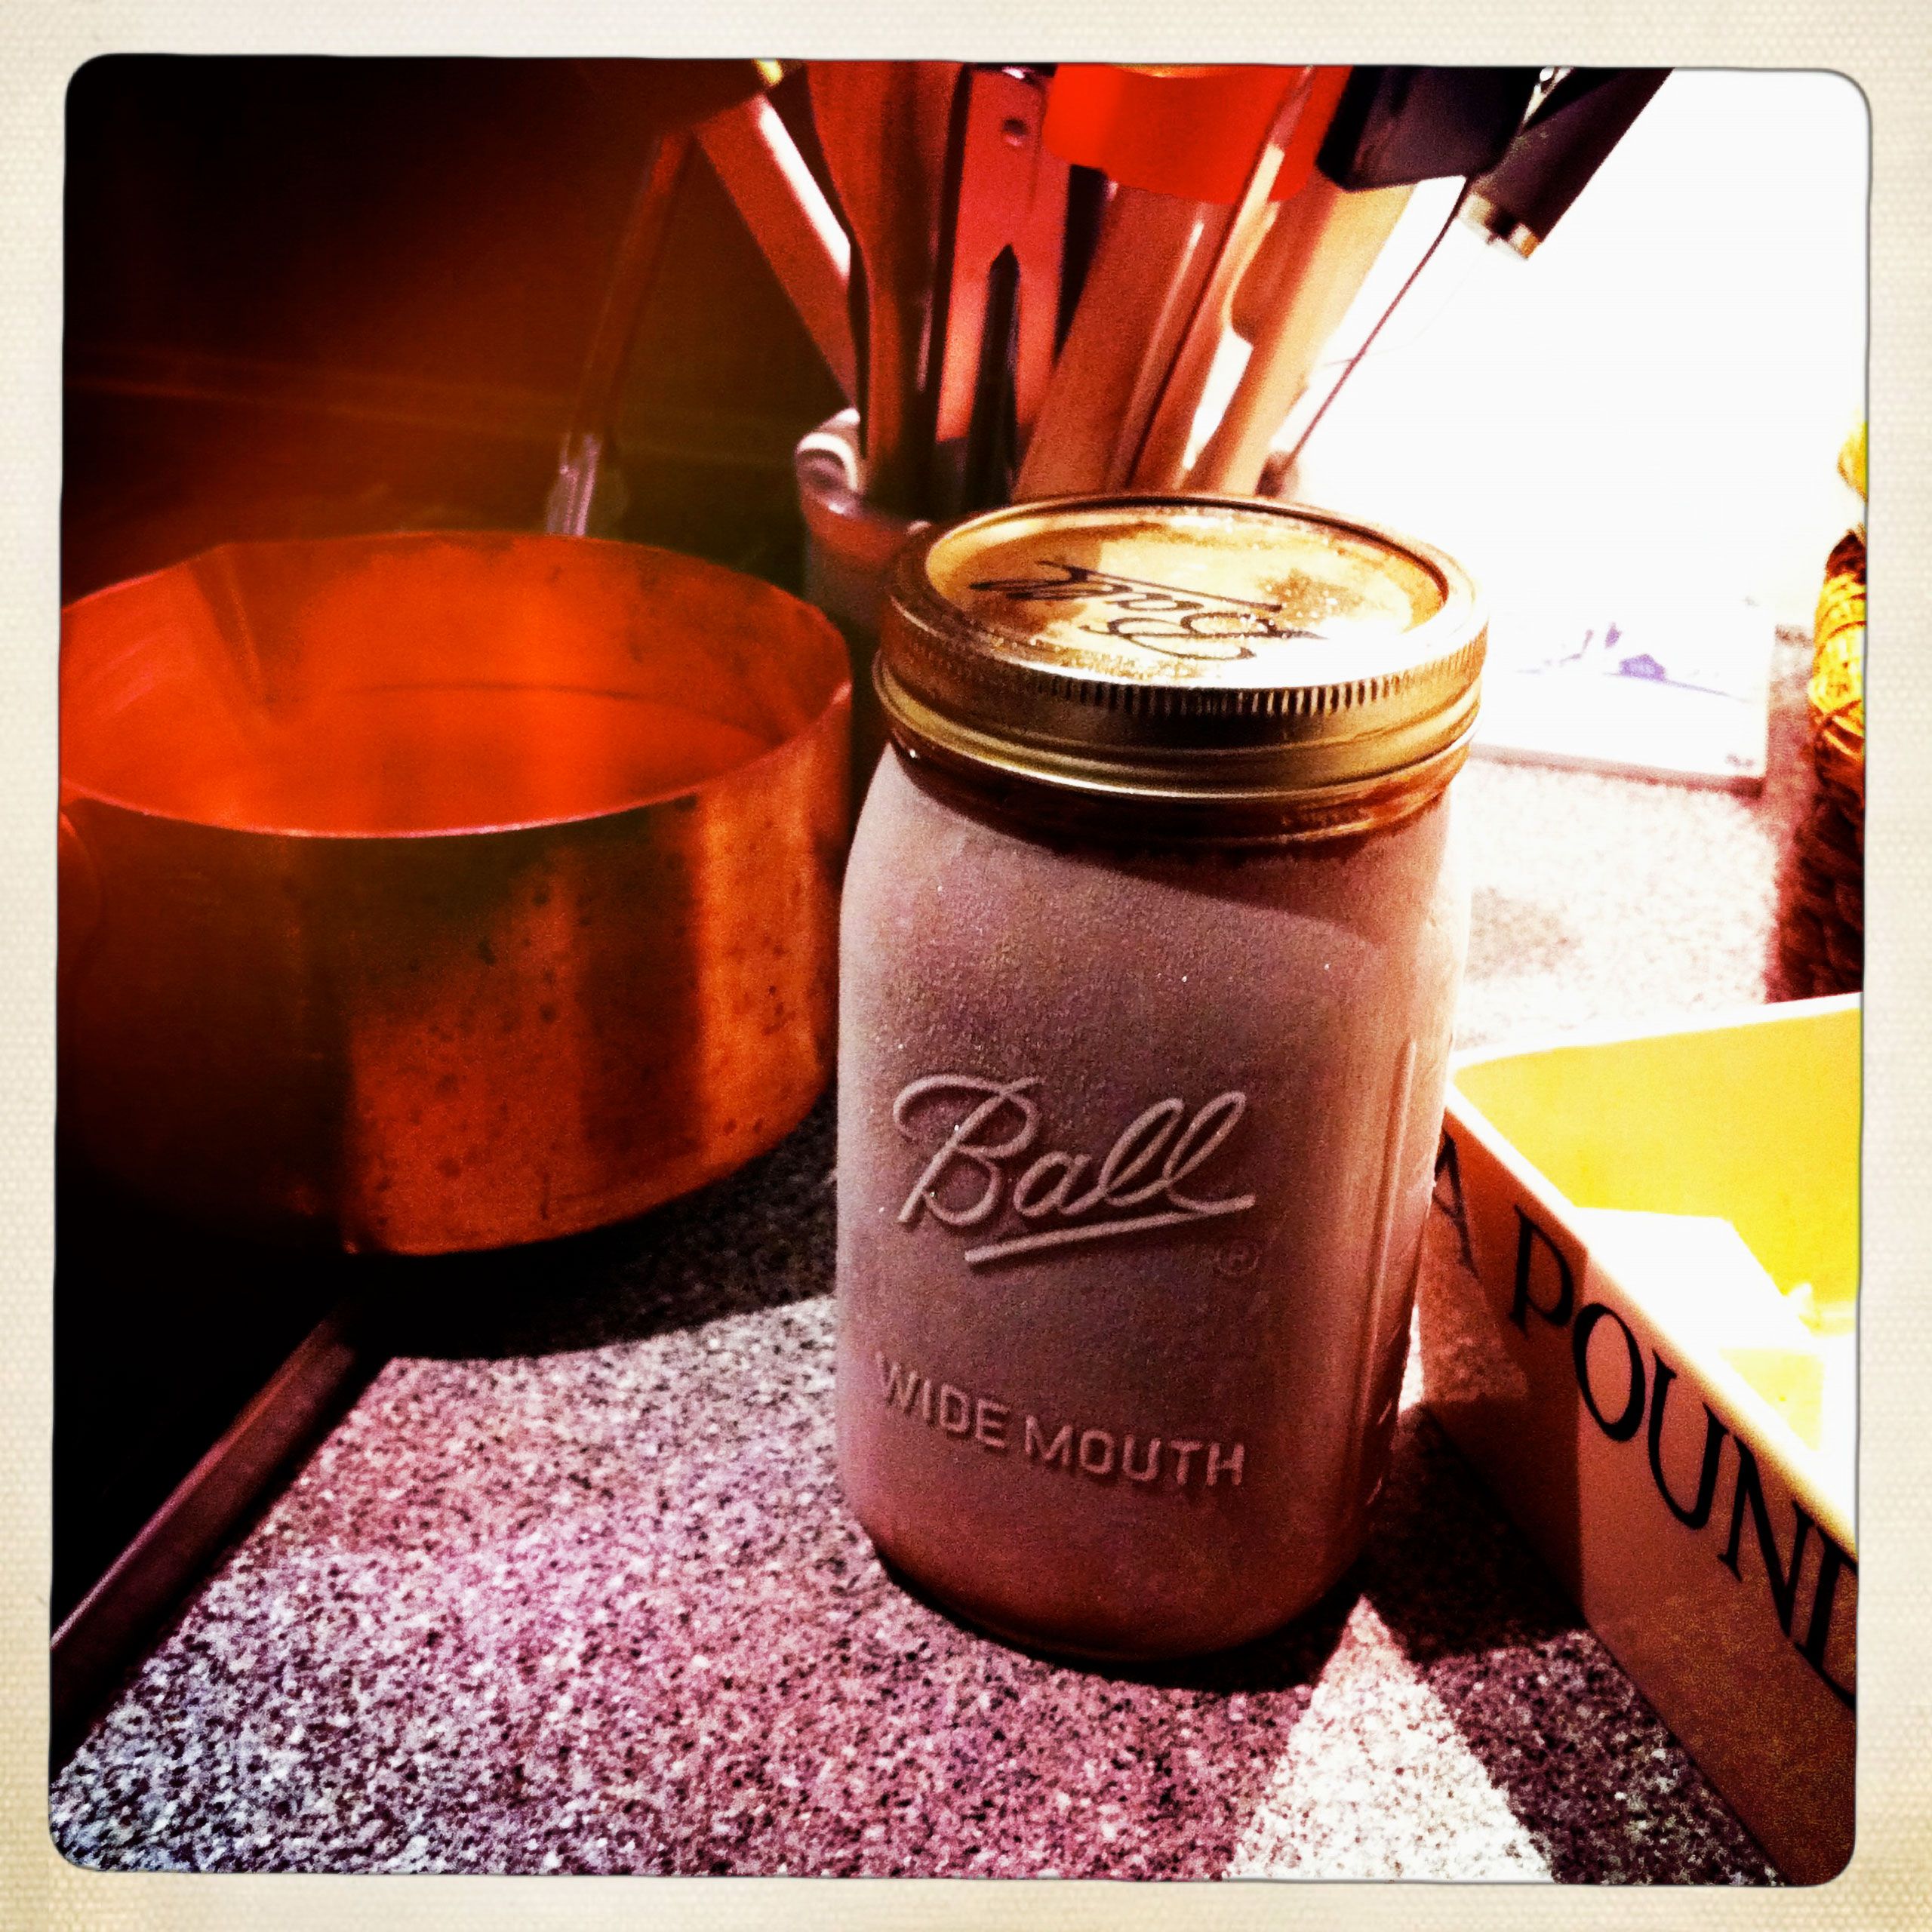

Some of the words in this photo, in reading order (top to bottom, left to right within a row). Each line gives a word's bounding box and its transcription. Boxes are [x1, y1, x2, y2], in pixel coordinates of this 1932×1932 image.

[894, 1074, 1256, 1264] Ball
[876, 1352, 1010, 1449] WIDE
[1024, 1414, 1245, 1485] MOUTH
